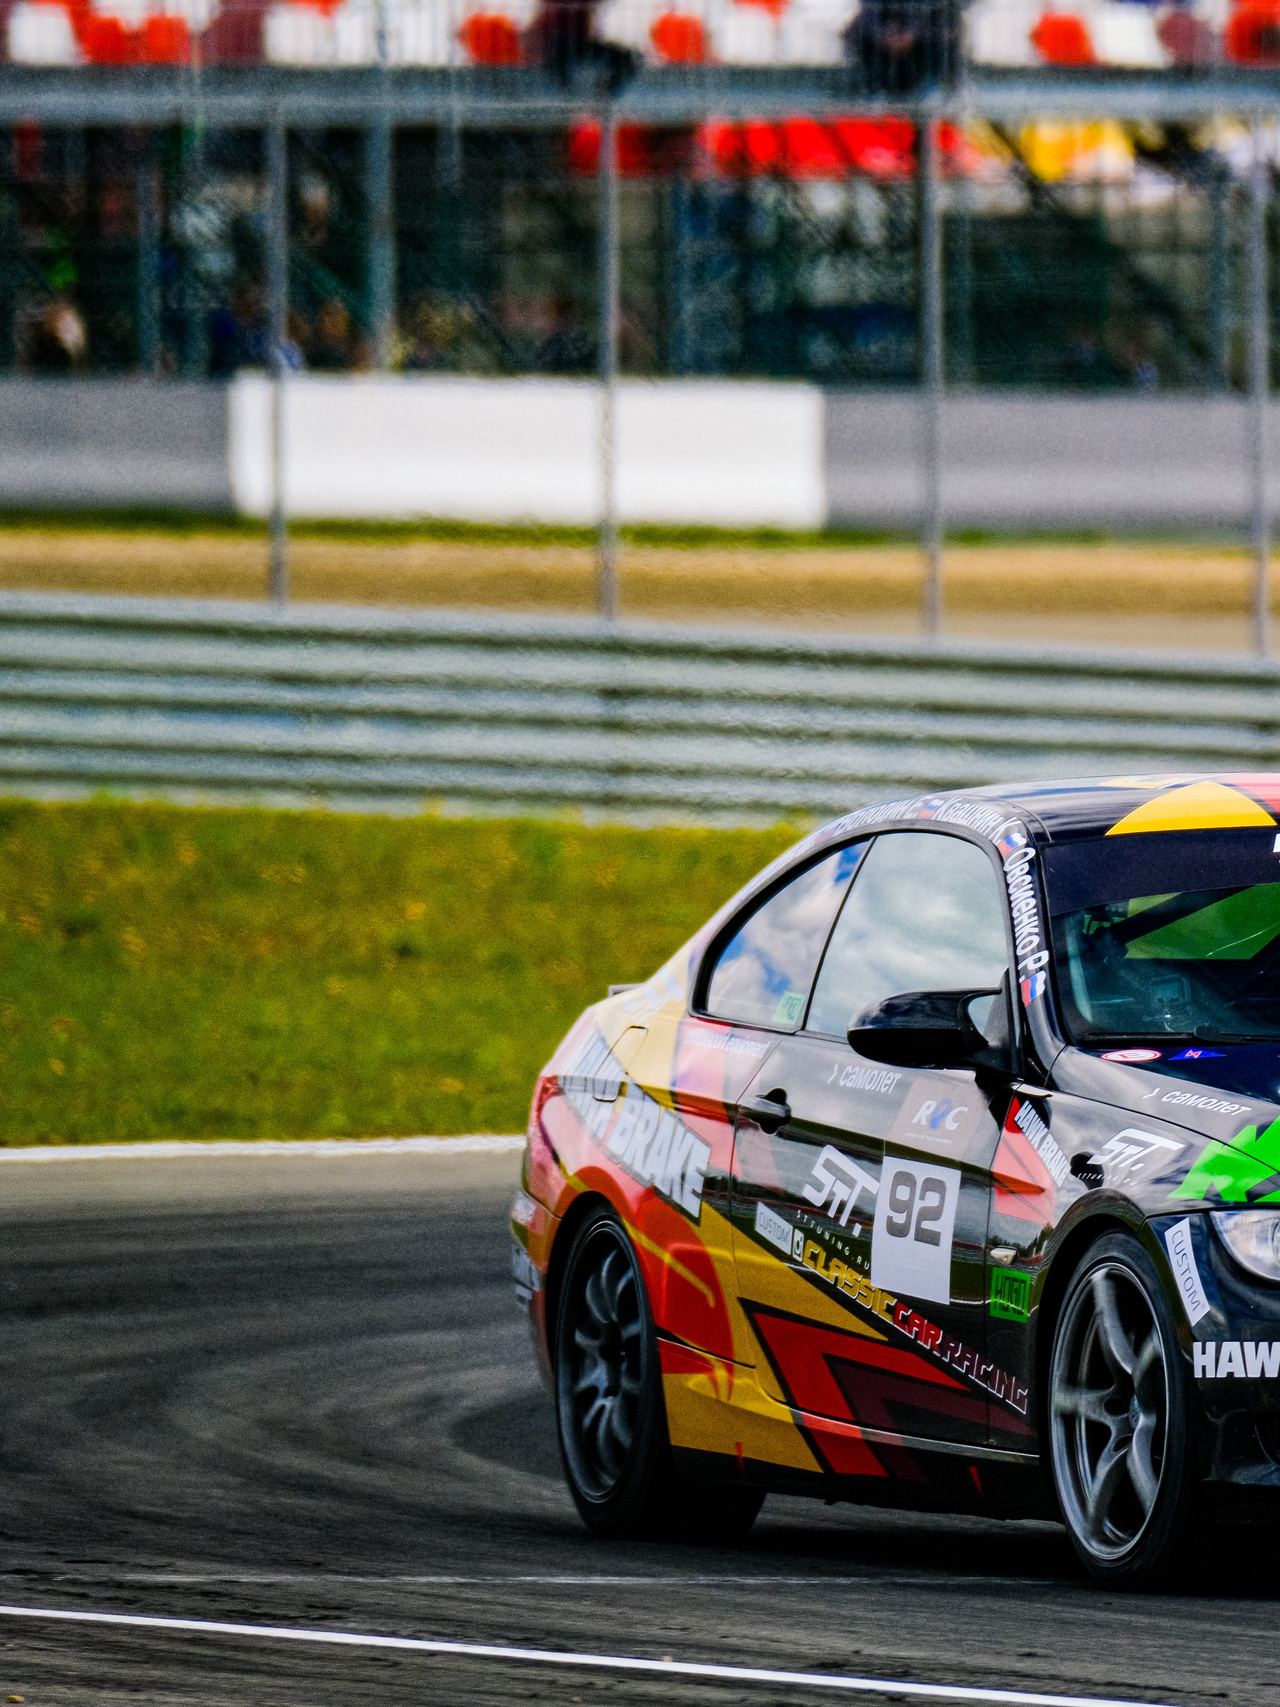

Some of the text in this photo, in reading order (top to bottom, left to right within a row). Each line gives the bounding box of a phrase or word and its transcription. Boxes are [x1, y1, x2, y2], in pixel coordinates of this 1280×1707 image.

[1003, 847, 1040, 956] Овсиенко
[839, 1065, 903, 1094] самолет
[1161, 1090, 1253, 1116] самолет
[604, 1083, 711, 1218] BRAKE
[1014, 1100, 1049, 1150] HAWK
[886, 1170, 947, 1247] 92
